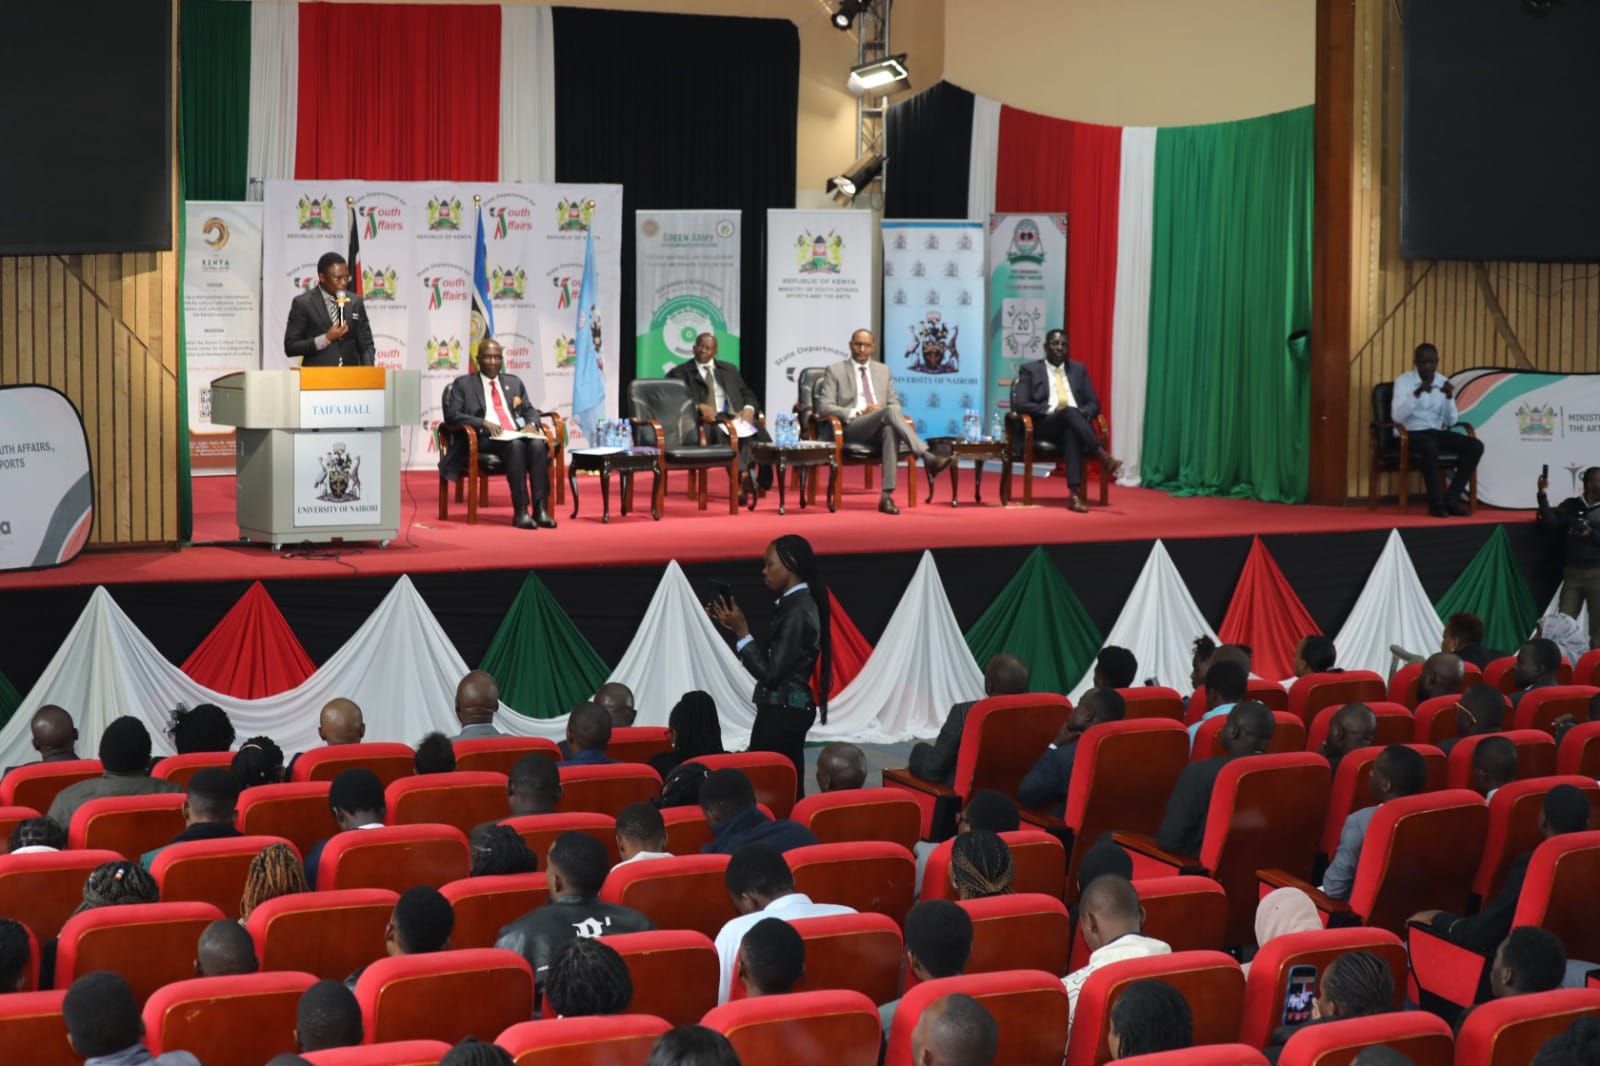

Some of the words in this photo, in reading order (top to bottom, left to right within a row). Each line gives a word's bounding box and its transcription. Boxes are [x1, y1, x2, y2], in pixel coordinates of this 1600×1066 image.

[782, 277, 818, 285] REPUBLIC
[1018, 318, 1029, 331] 20
[377, 347, 400, 358] outh
[774, 351, 795, 366] State
[893, 376, 932, 384] NIVERSITY
[946, 377, 978, 385] NAIROBI
[313, 404, 342, 416] TAIFA
[344, 404, 372, 415] HALL
[1568, 424, 1585, 432] THE
[297, 505, 338, 513] UNIVERSITY
[339, 505, 348, 513] OF
[350, 504, 378, 513] NAIROBI
